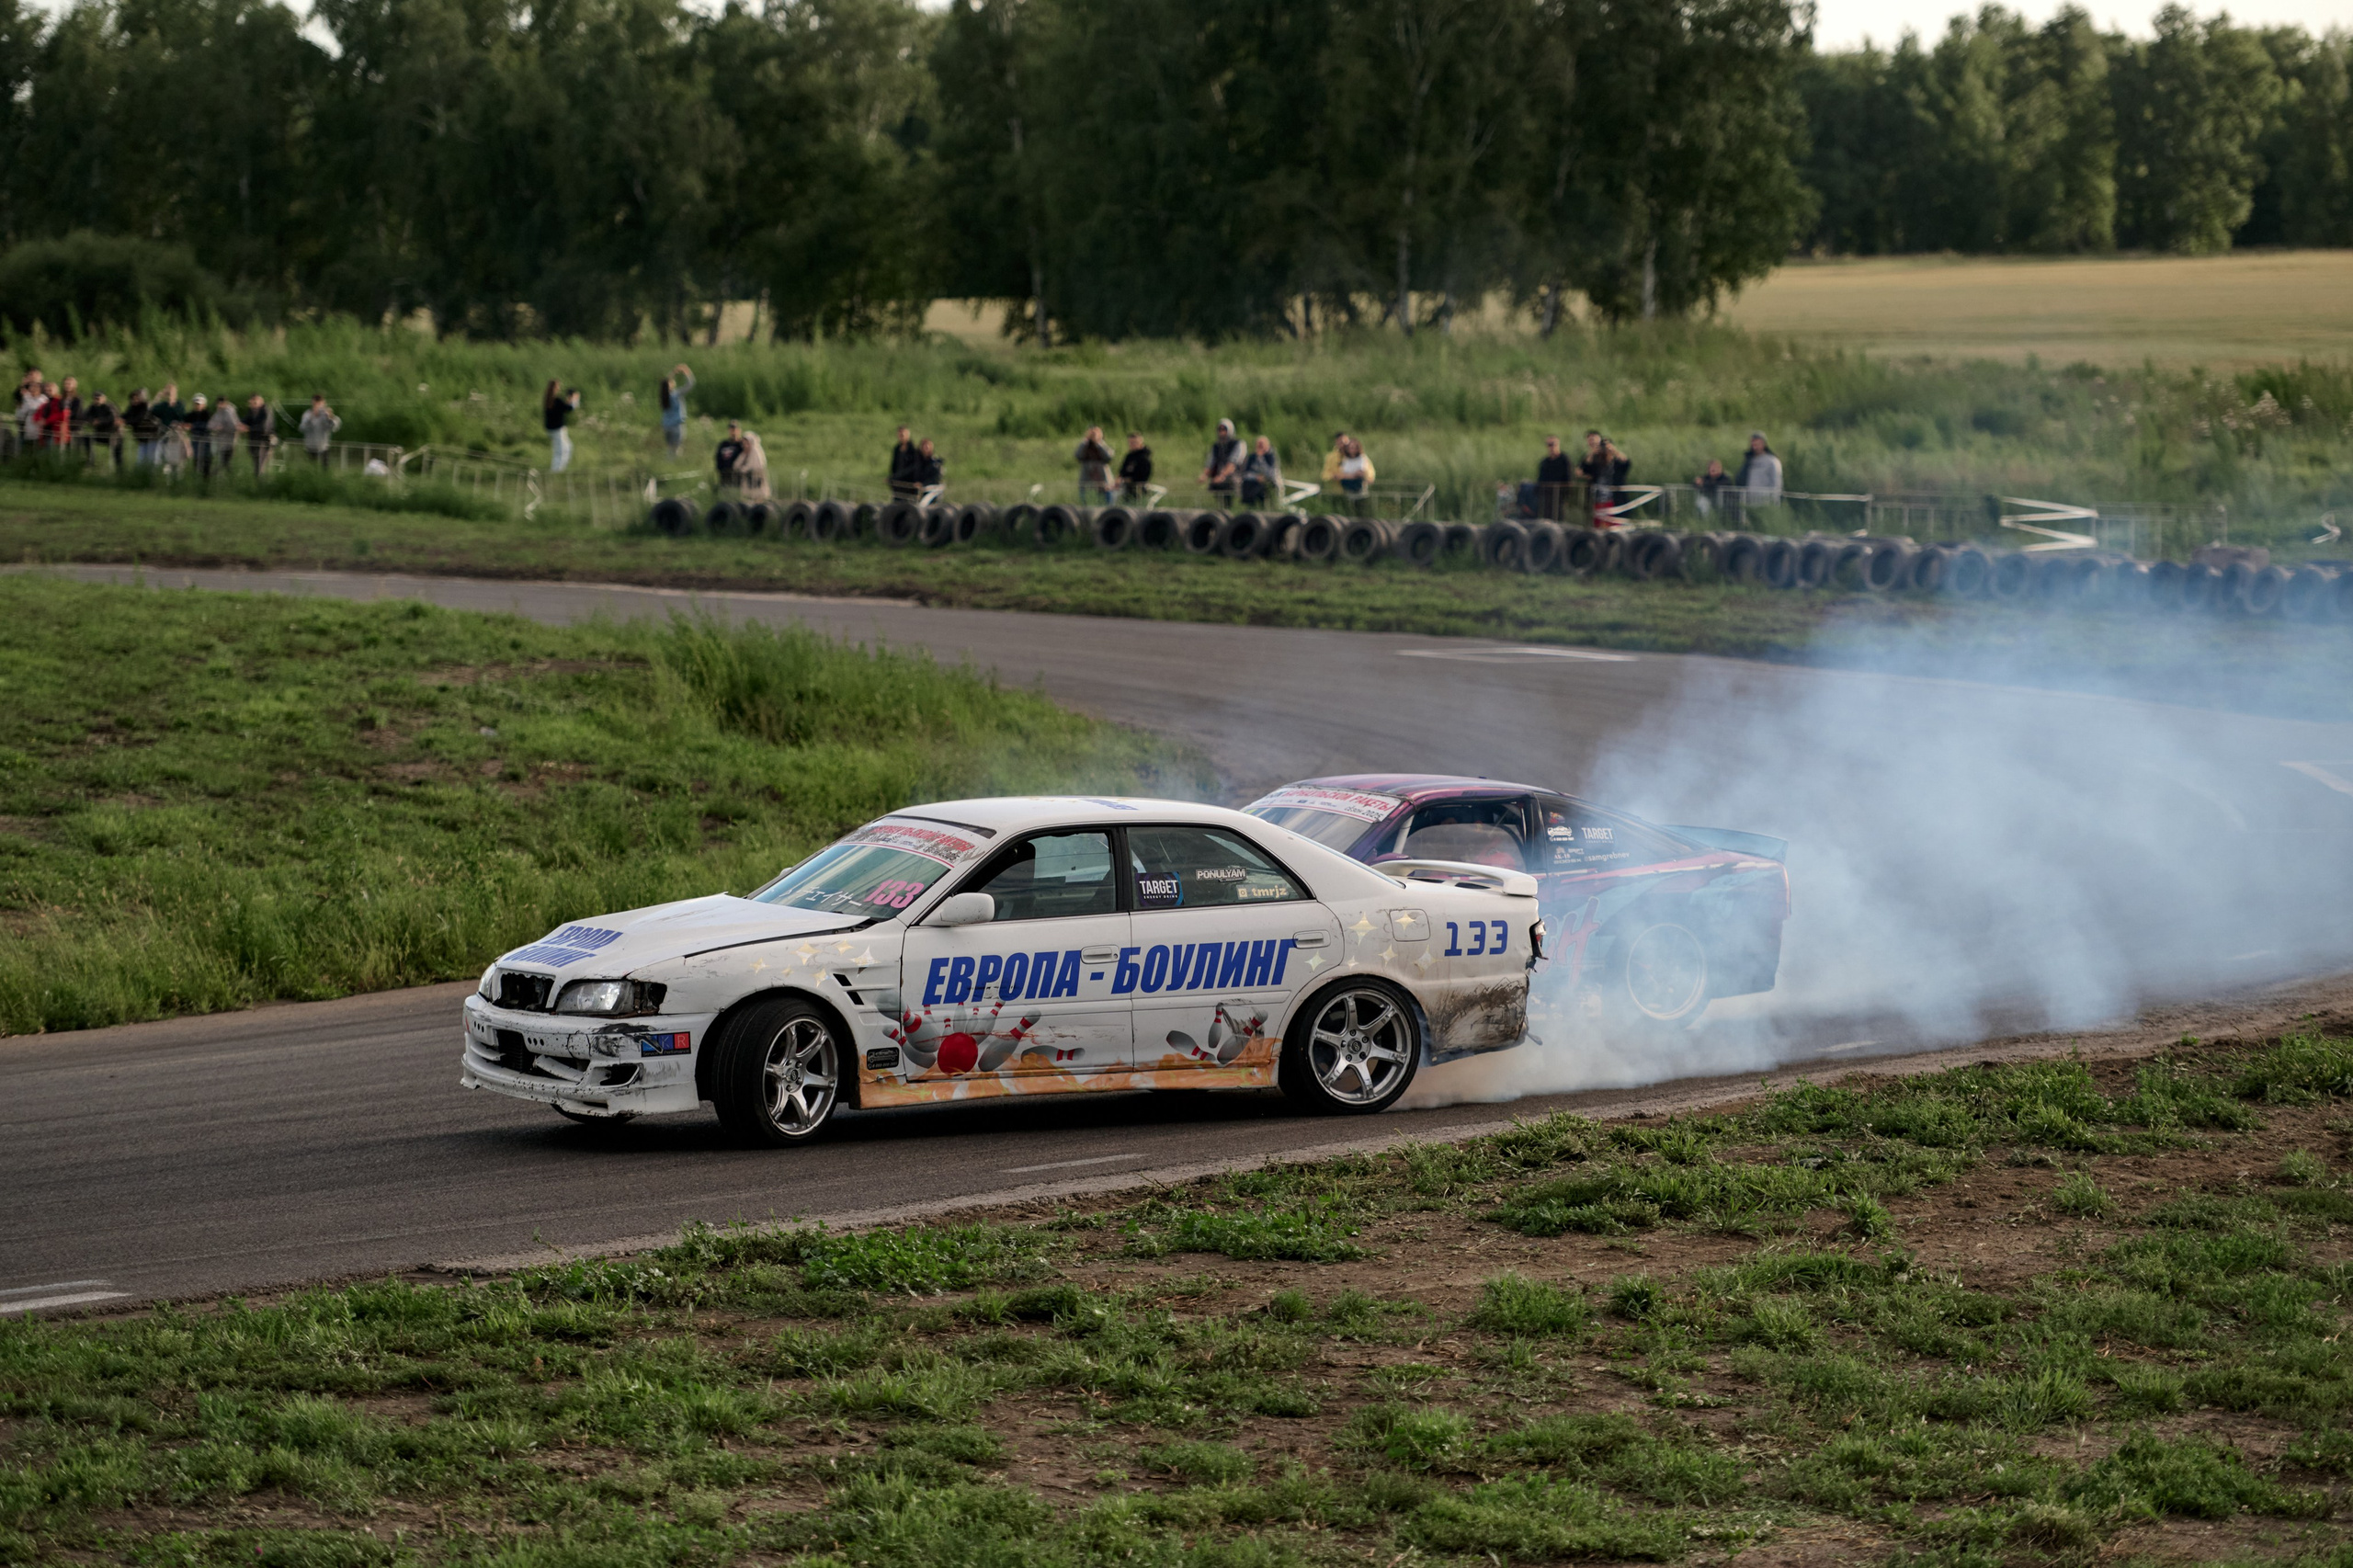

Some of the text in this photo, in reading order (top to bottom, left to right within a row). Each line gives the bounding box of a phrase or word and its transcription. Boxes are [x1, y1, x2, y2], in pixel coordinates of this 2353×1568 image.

[1581, 827, 1614, 840] TARGET
[1197, 869, 1245, 880] PONULYAM
[863, 879, 925, 909] 133
[1139, 880, 1179, 895] TARGET
[1251, 885, 1288, 899] tmrjz
[540, 926, 624, 951] ЕВРОПА
[1444, 920, 1509, 957] 133
[922, 949, 1081, 1006] ЕВРОПА
[1111, 938, 1299, 995] БОУЛИНГ
